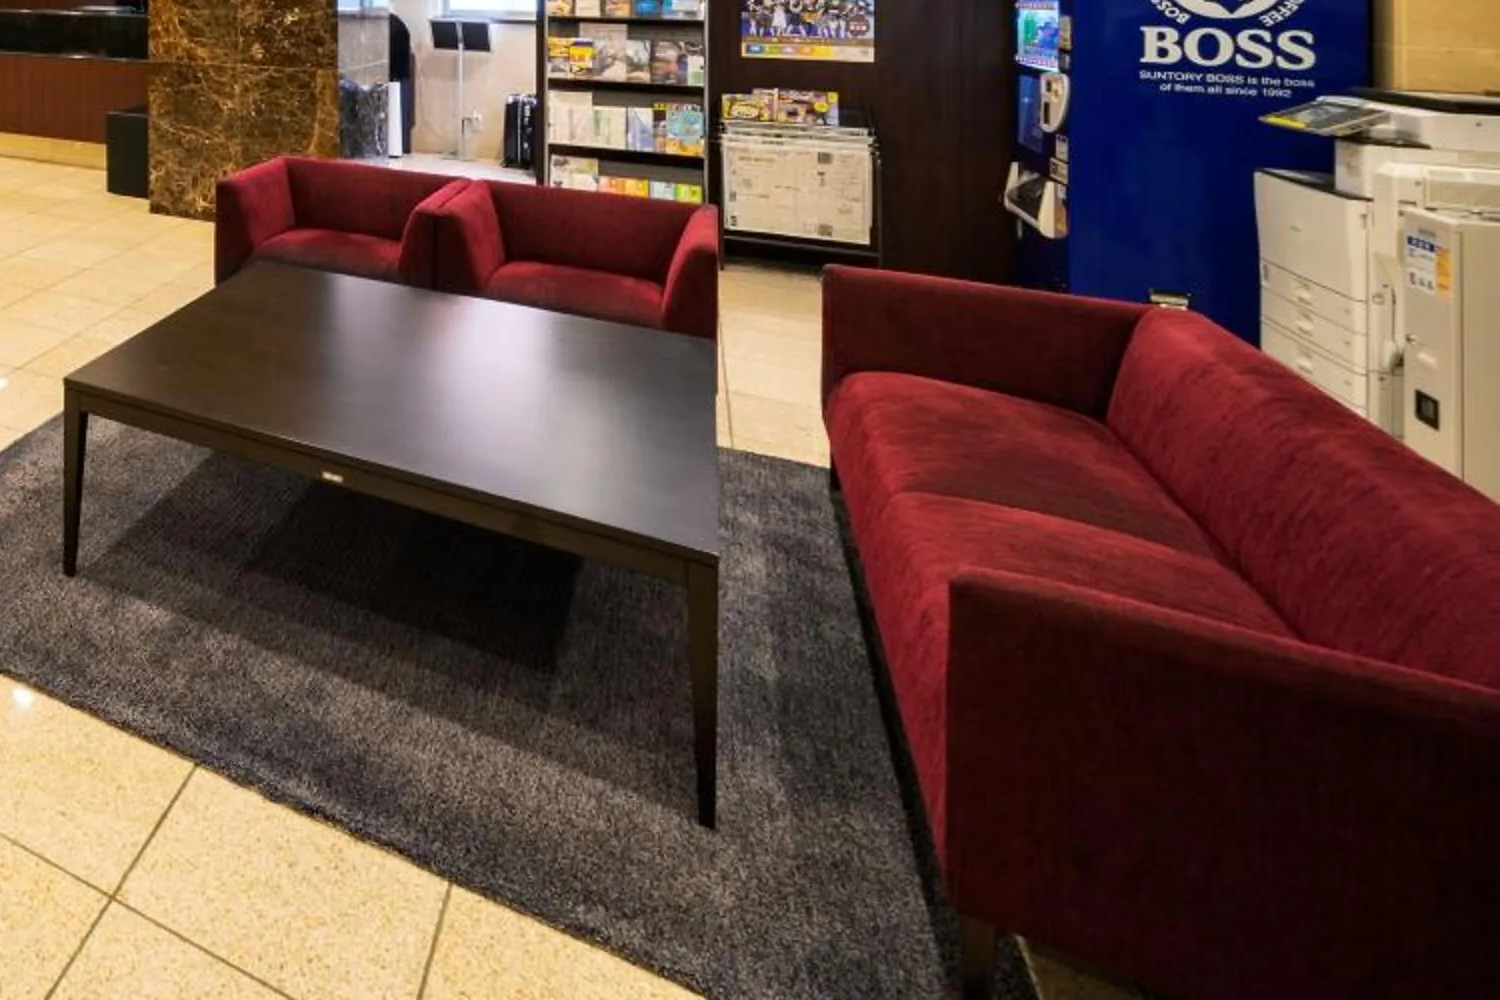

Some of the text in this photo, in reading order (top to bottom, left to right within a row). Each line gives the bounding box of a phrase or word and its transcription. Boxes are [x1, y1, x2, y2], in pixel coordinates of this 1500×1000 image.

[1139, 26, 1316, 70] BOSS
[1139, 69, 1316, 88] SUNTORY BOSS is the boss
[1159, 82, 1172, 92] of
[1174, 82, 1205, 93] them
[1207, 85, 1223, 95] all
[1225, 87, 1258, 97] since
